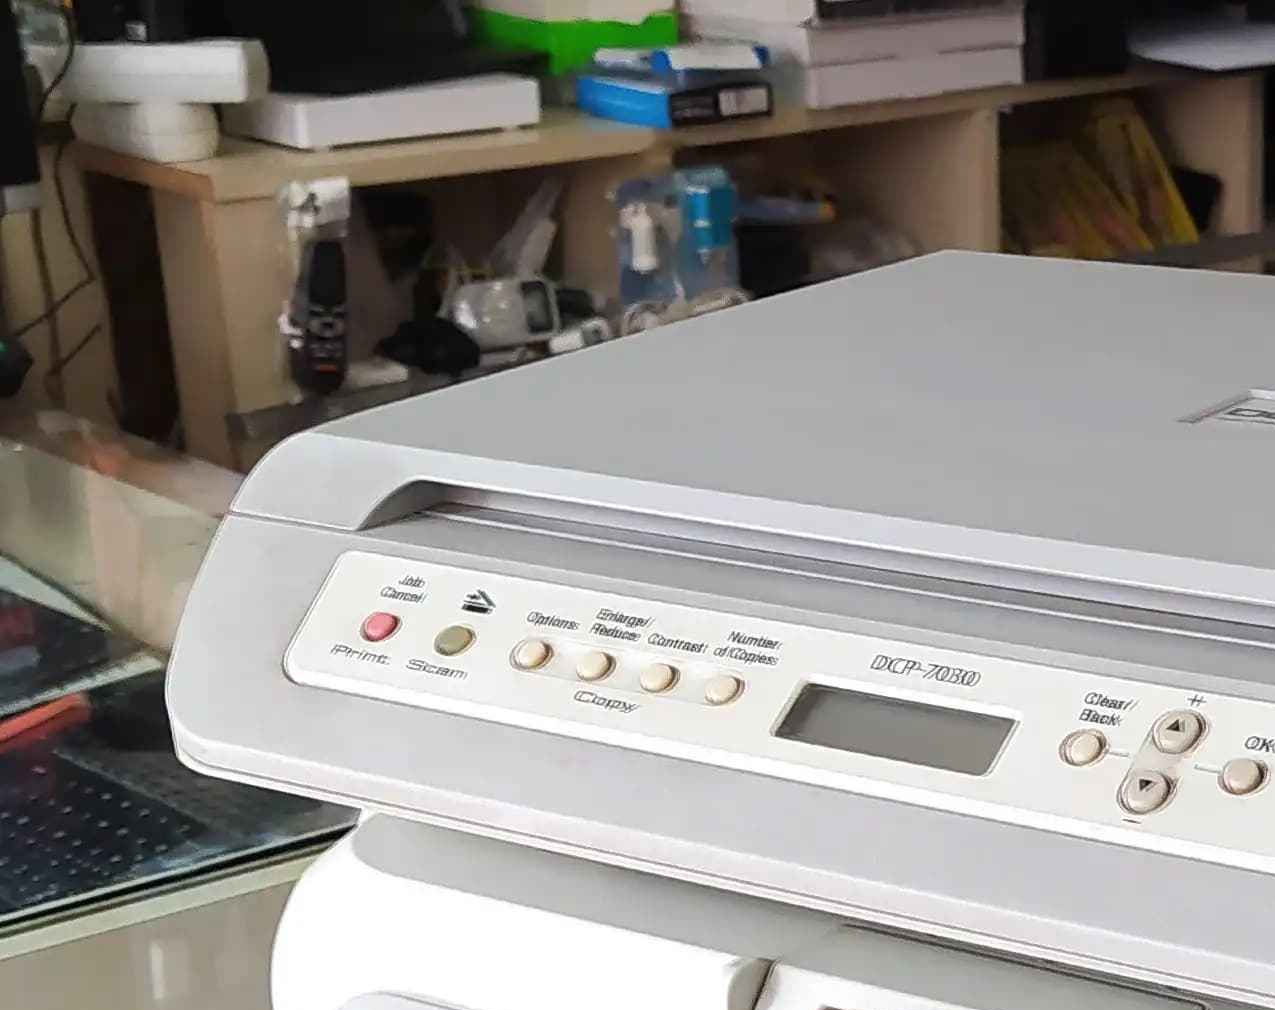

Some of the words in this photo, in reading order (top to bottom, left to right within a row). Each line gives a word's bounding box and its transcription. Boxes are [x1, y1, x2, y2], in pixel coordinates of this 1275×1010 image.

[398, 575, 425, 588] Job
[380, 586, 427, 604] Cancel
[526, 611, 579, 631] Options
[589, 623, 641, 642] Reduce
[727, 630, 783, 650] Number
[647, 633, 708, 654] Contrast
[331, 644, 390, 665] Print
[728, 647, 780, 666] Copies
[406, 659, 468, 680] Scan
[870, 654, 982, 687] DCP-7030
[573, 690, 640, 713] Copy
[1079, 709, 1121, 726] Back
